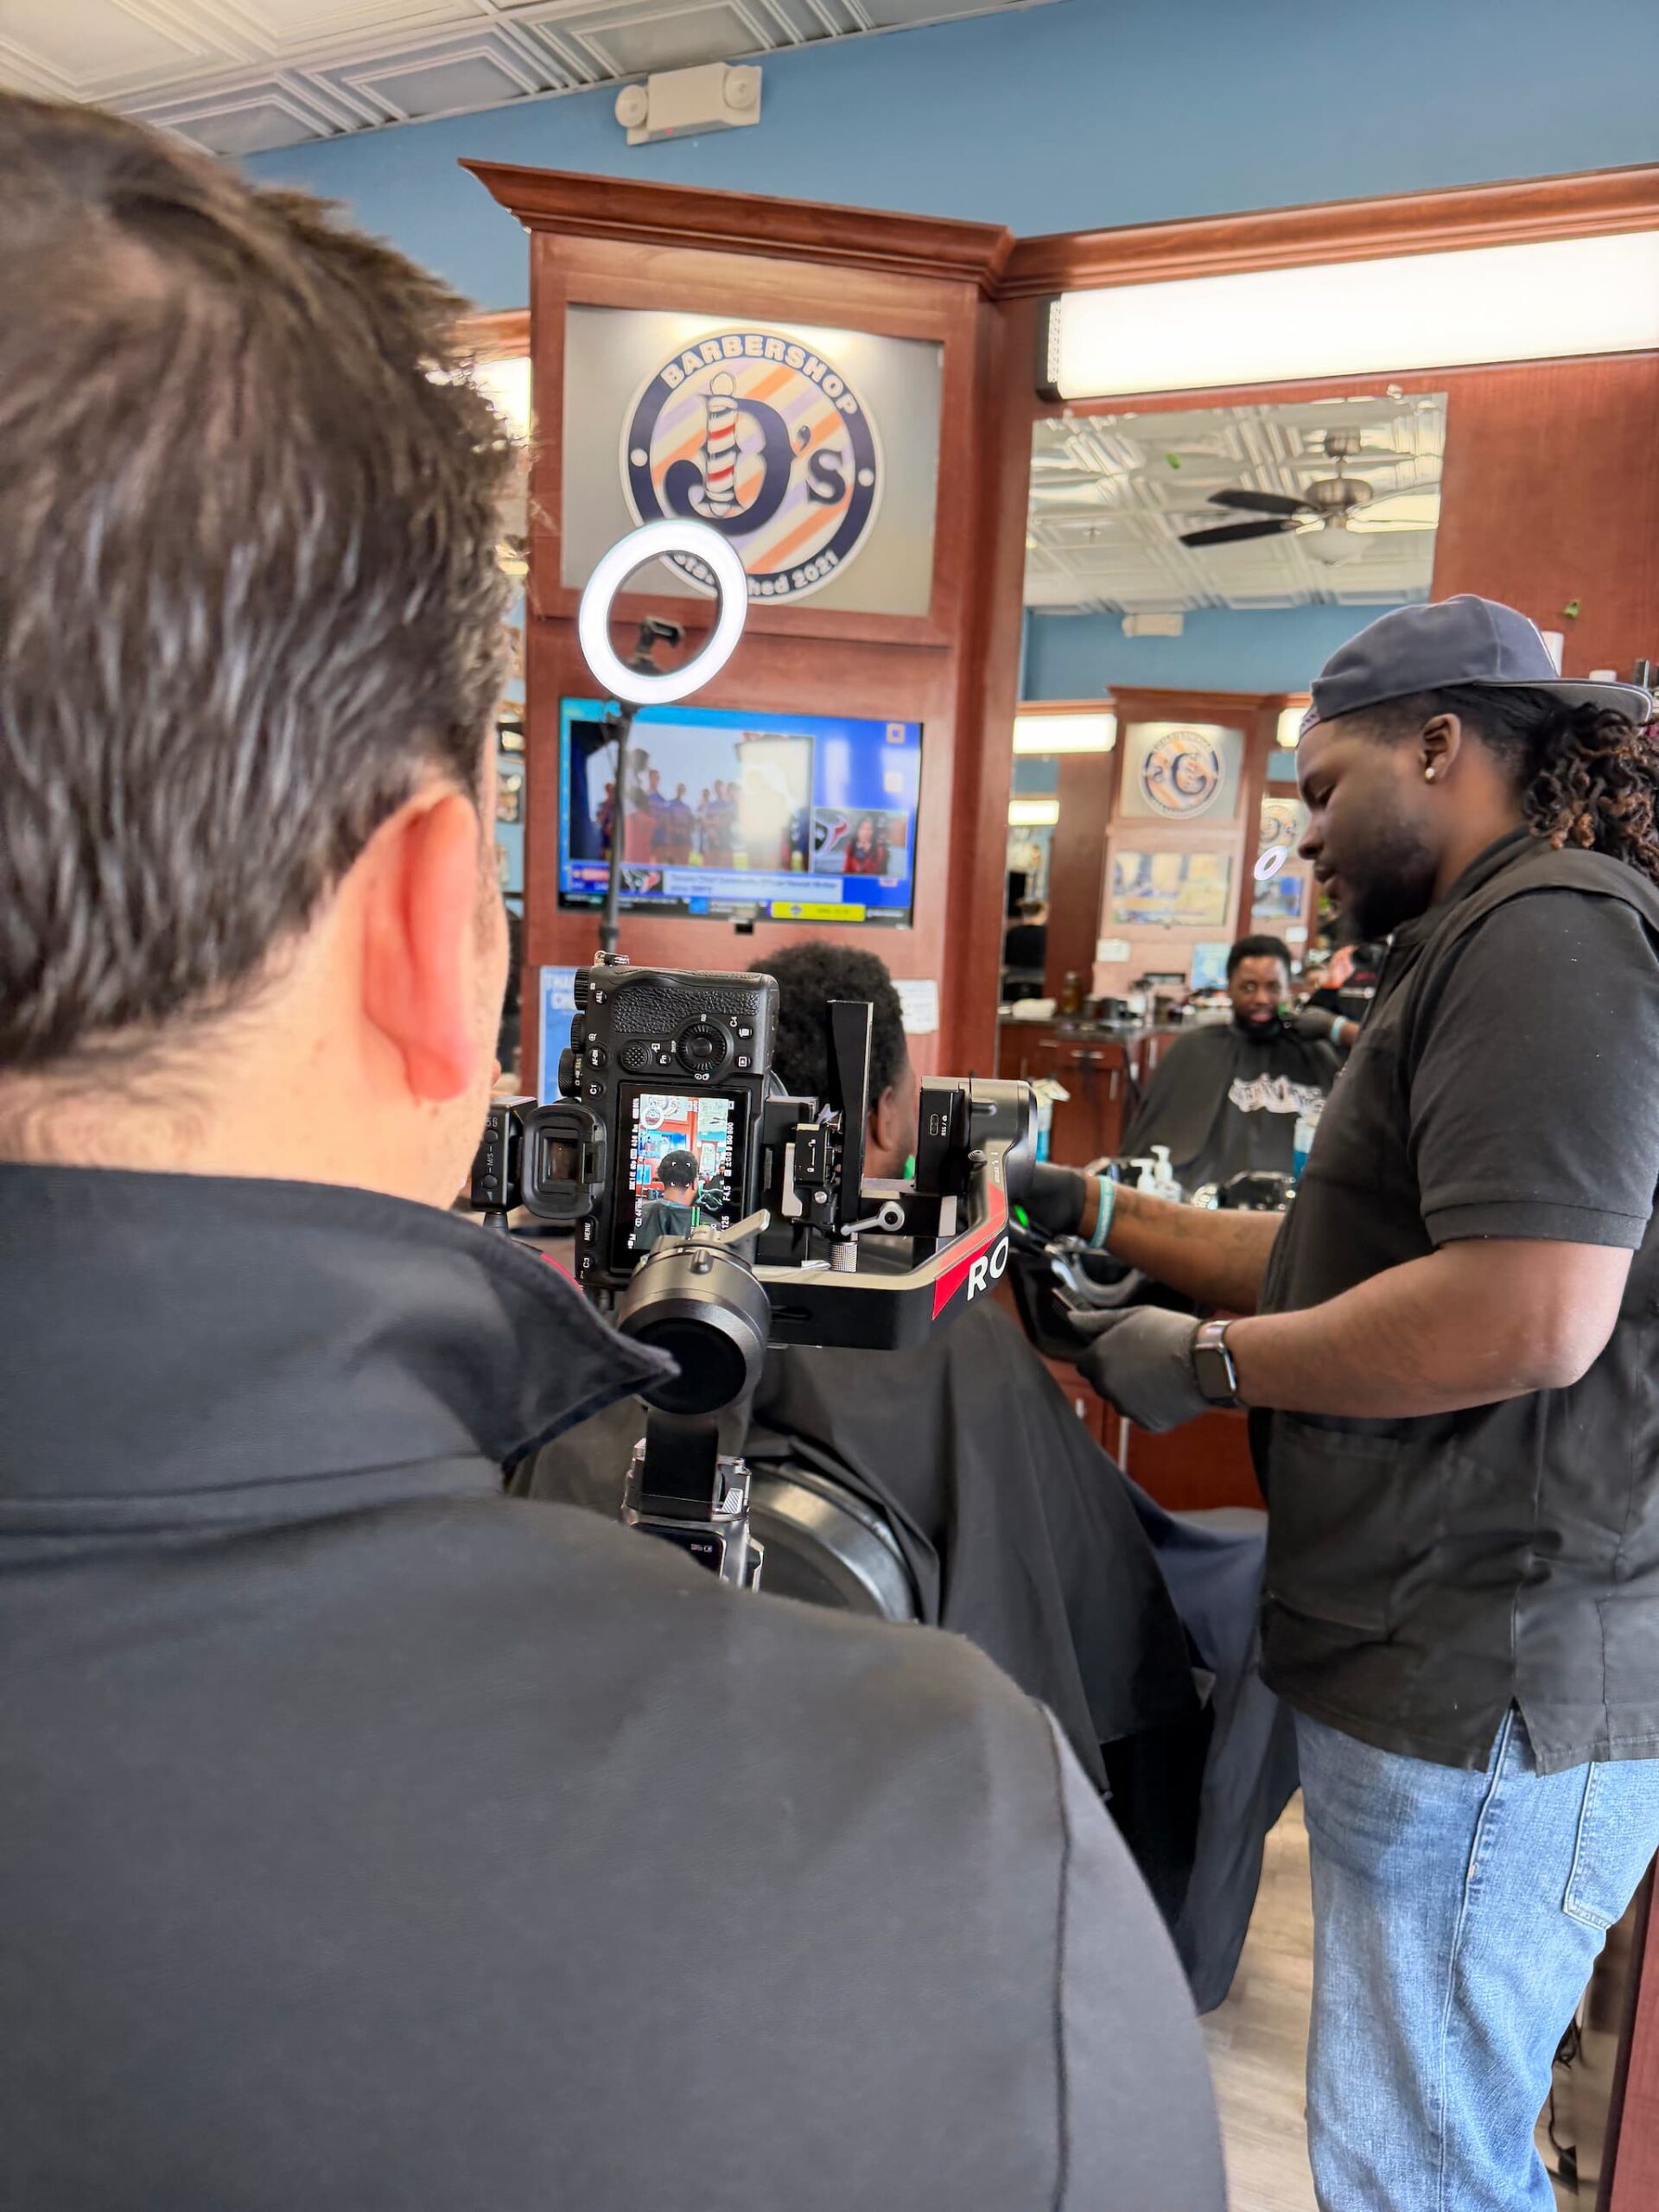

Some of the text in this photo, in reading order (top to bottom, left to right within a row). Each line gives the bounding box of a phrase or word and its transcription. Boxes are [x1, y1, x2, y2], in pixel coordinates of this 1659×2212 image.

[660, 334, 858, 415] BARBERSHOP
[791, 550, 839, 588] 2021
[730, 1016, 738, 1027] C4
[659, 1054, 667, 1064] Fn
[590, 1084, 597, 1095] C1
[583, 1257, 590, 1268] C3
[967, 1236, 1009, 1301] RO
